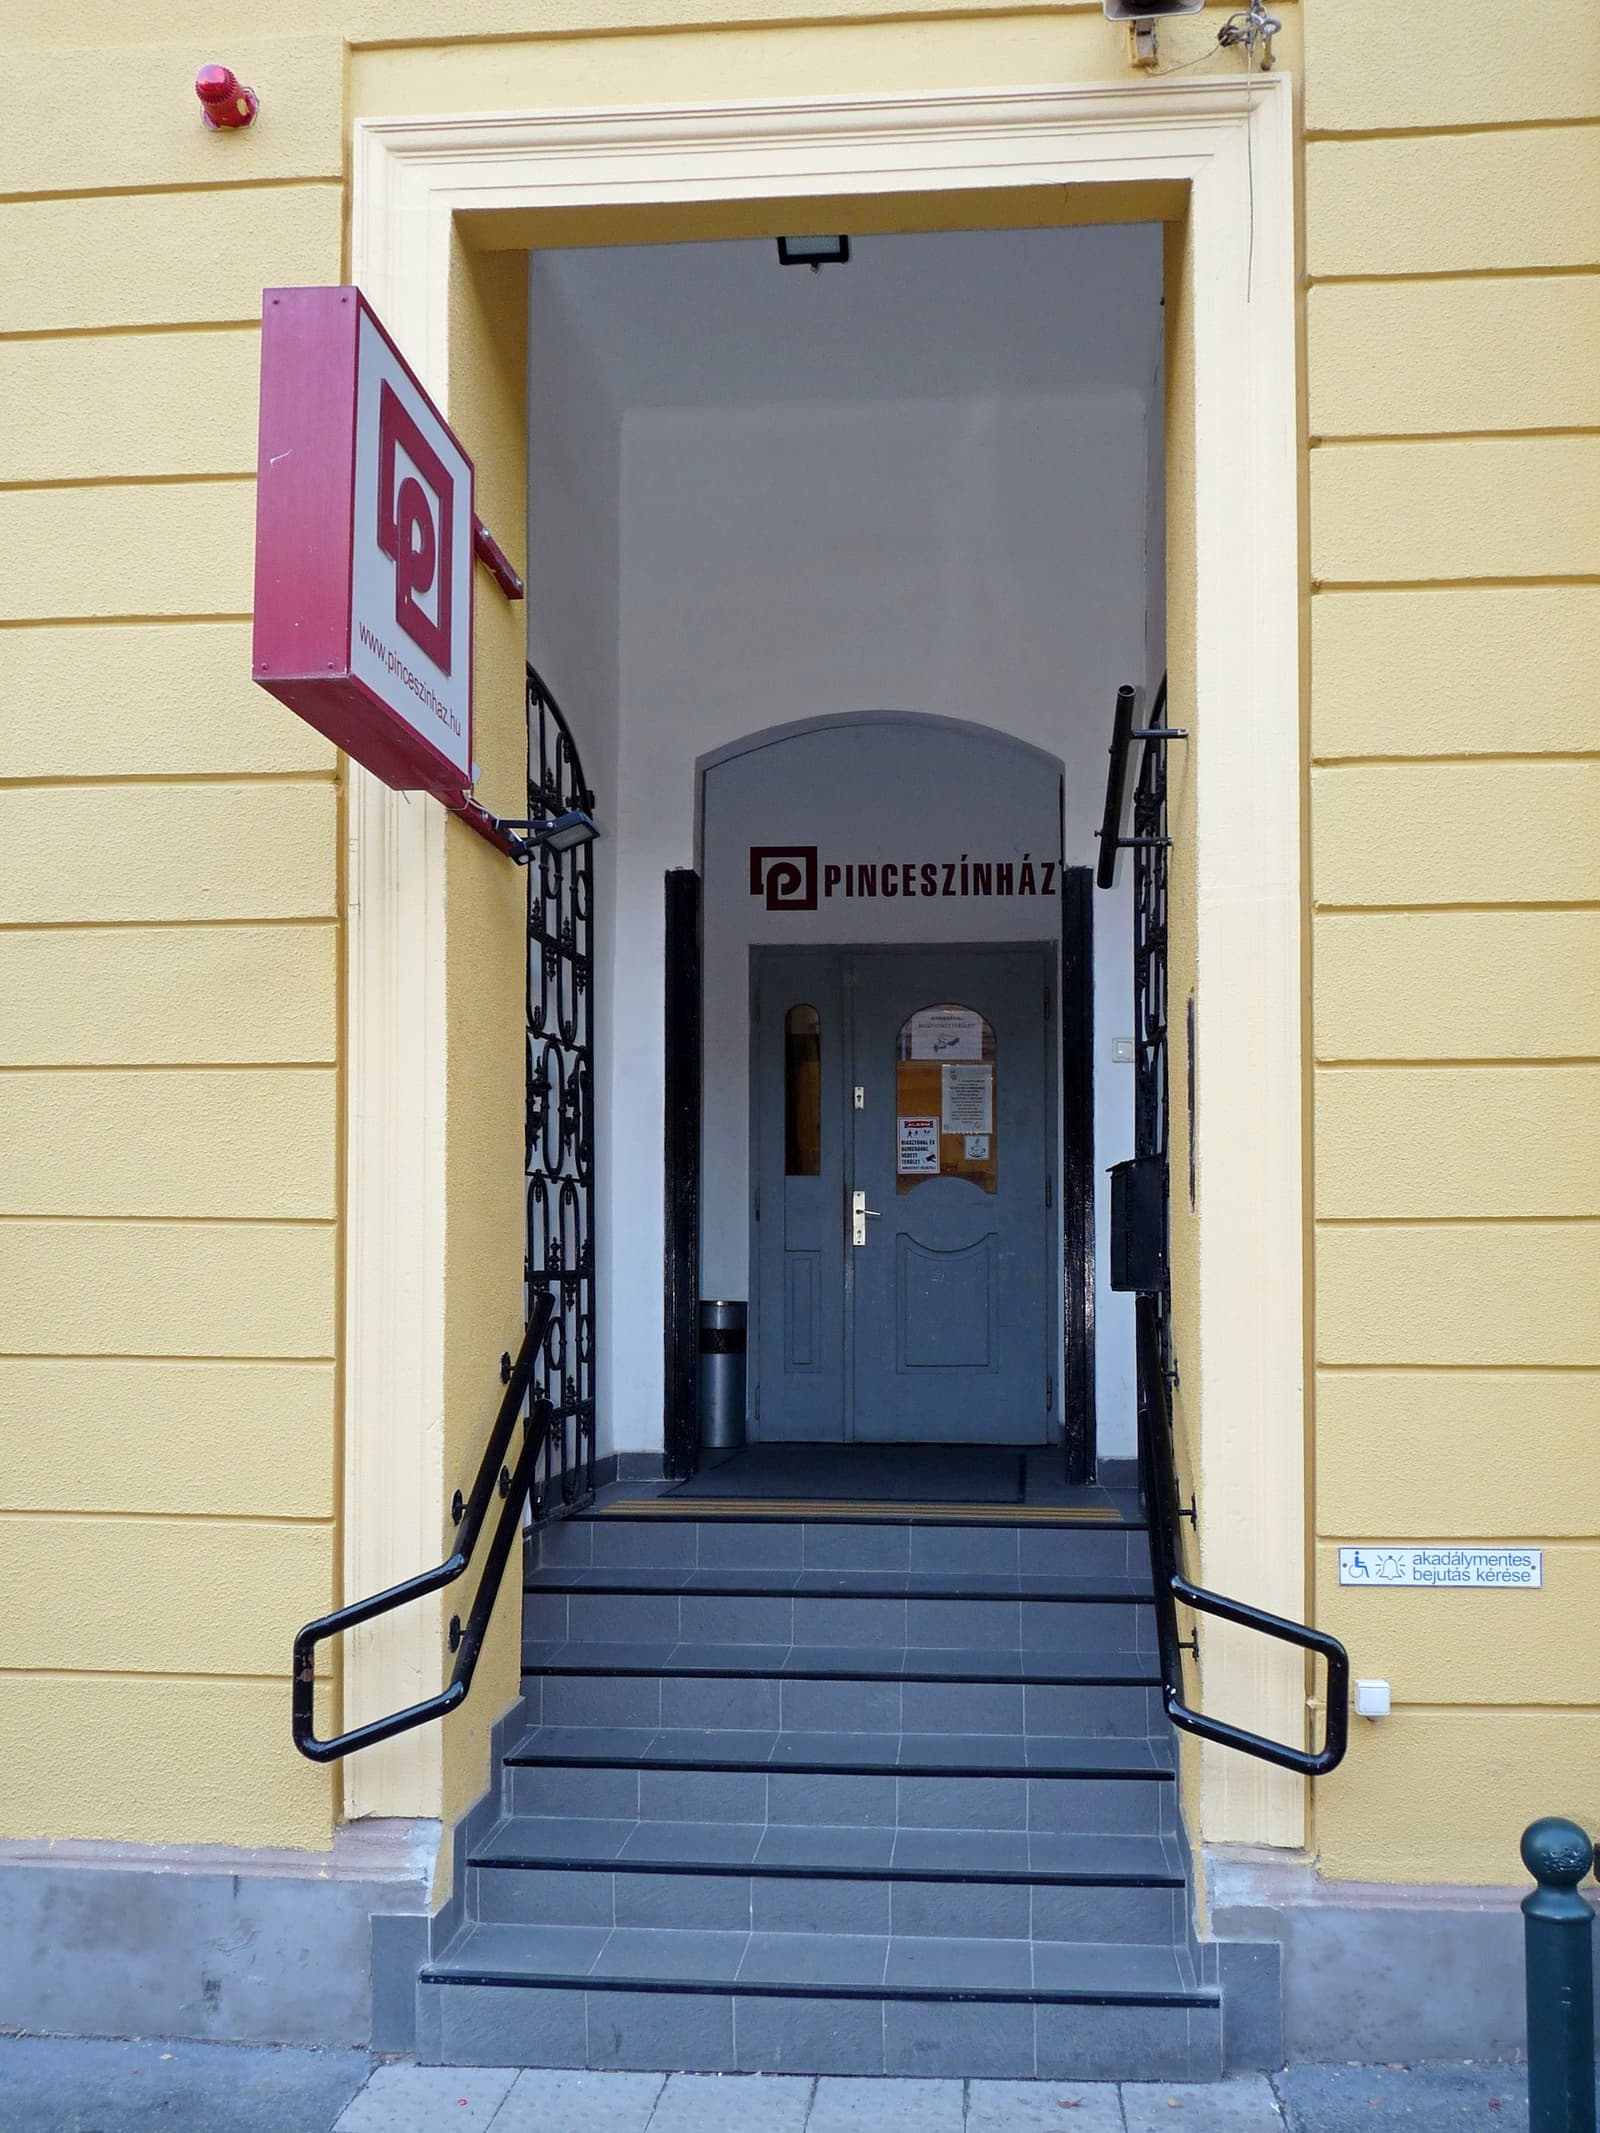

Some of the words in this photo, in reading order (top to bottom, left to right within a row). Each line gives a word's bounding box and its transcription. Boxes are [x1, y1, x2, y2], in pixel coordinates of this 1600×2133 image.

[359, 621, 461, 736] www.pinceszinhaz.hu
[824, 853, 1057, 897] PINCESZÍNHÁZ
[1412, 1551, 1531, 1568] akadálymentes
[1412, 1567, 1471, 1584] bejutás
[1477, 1567, 1531, 1582] kérése
